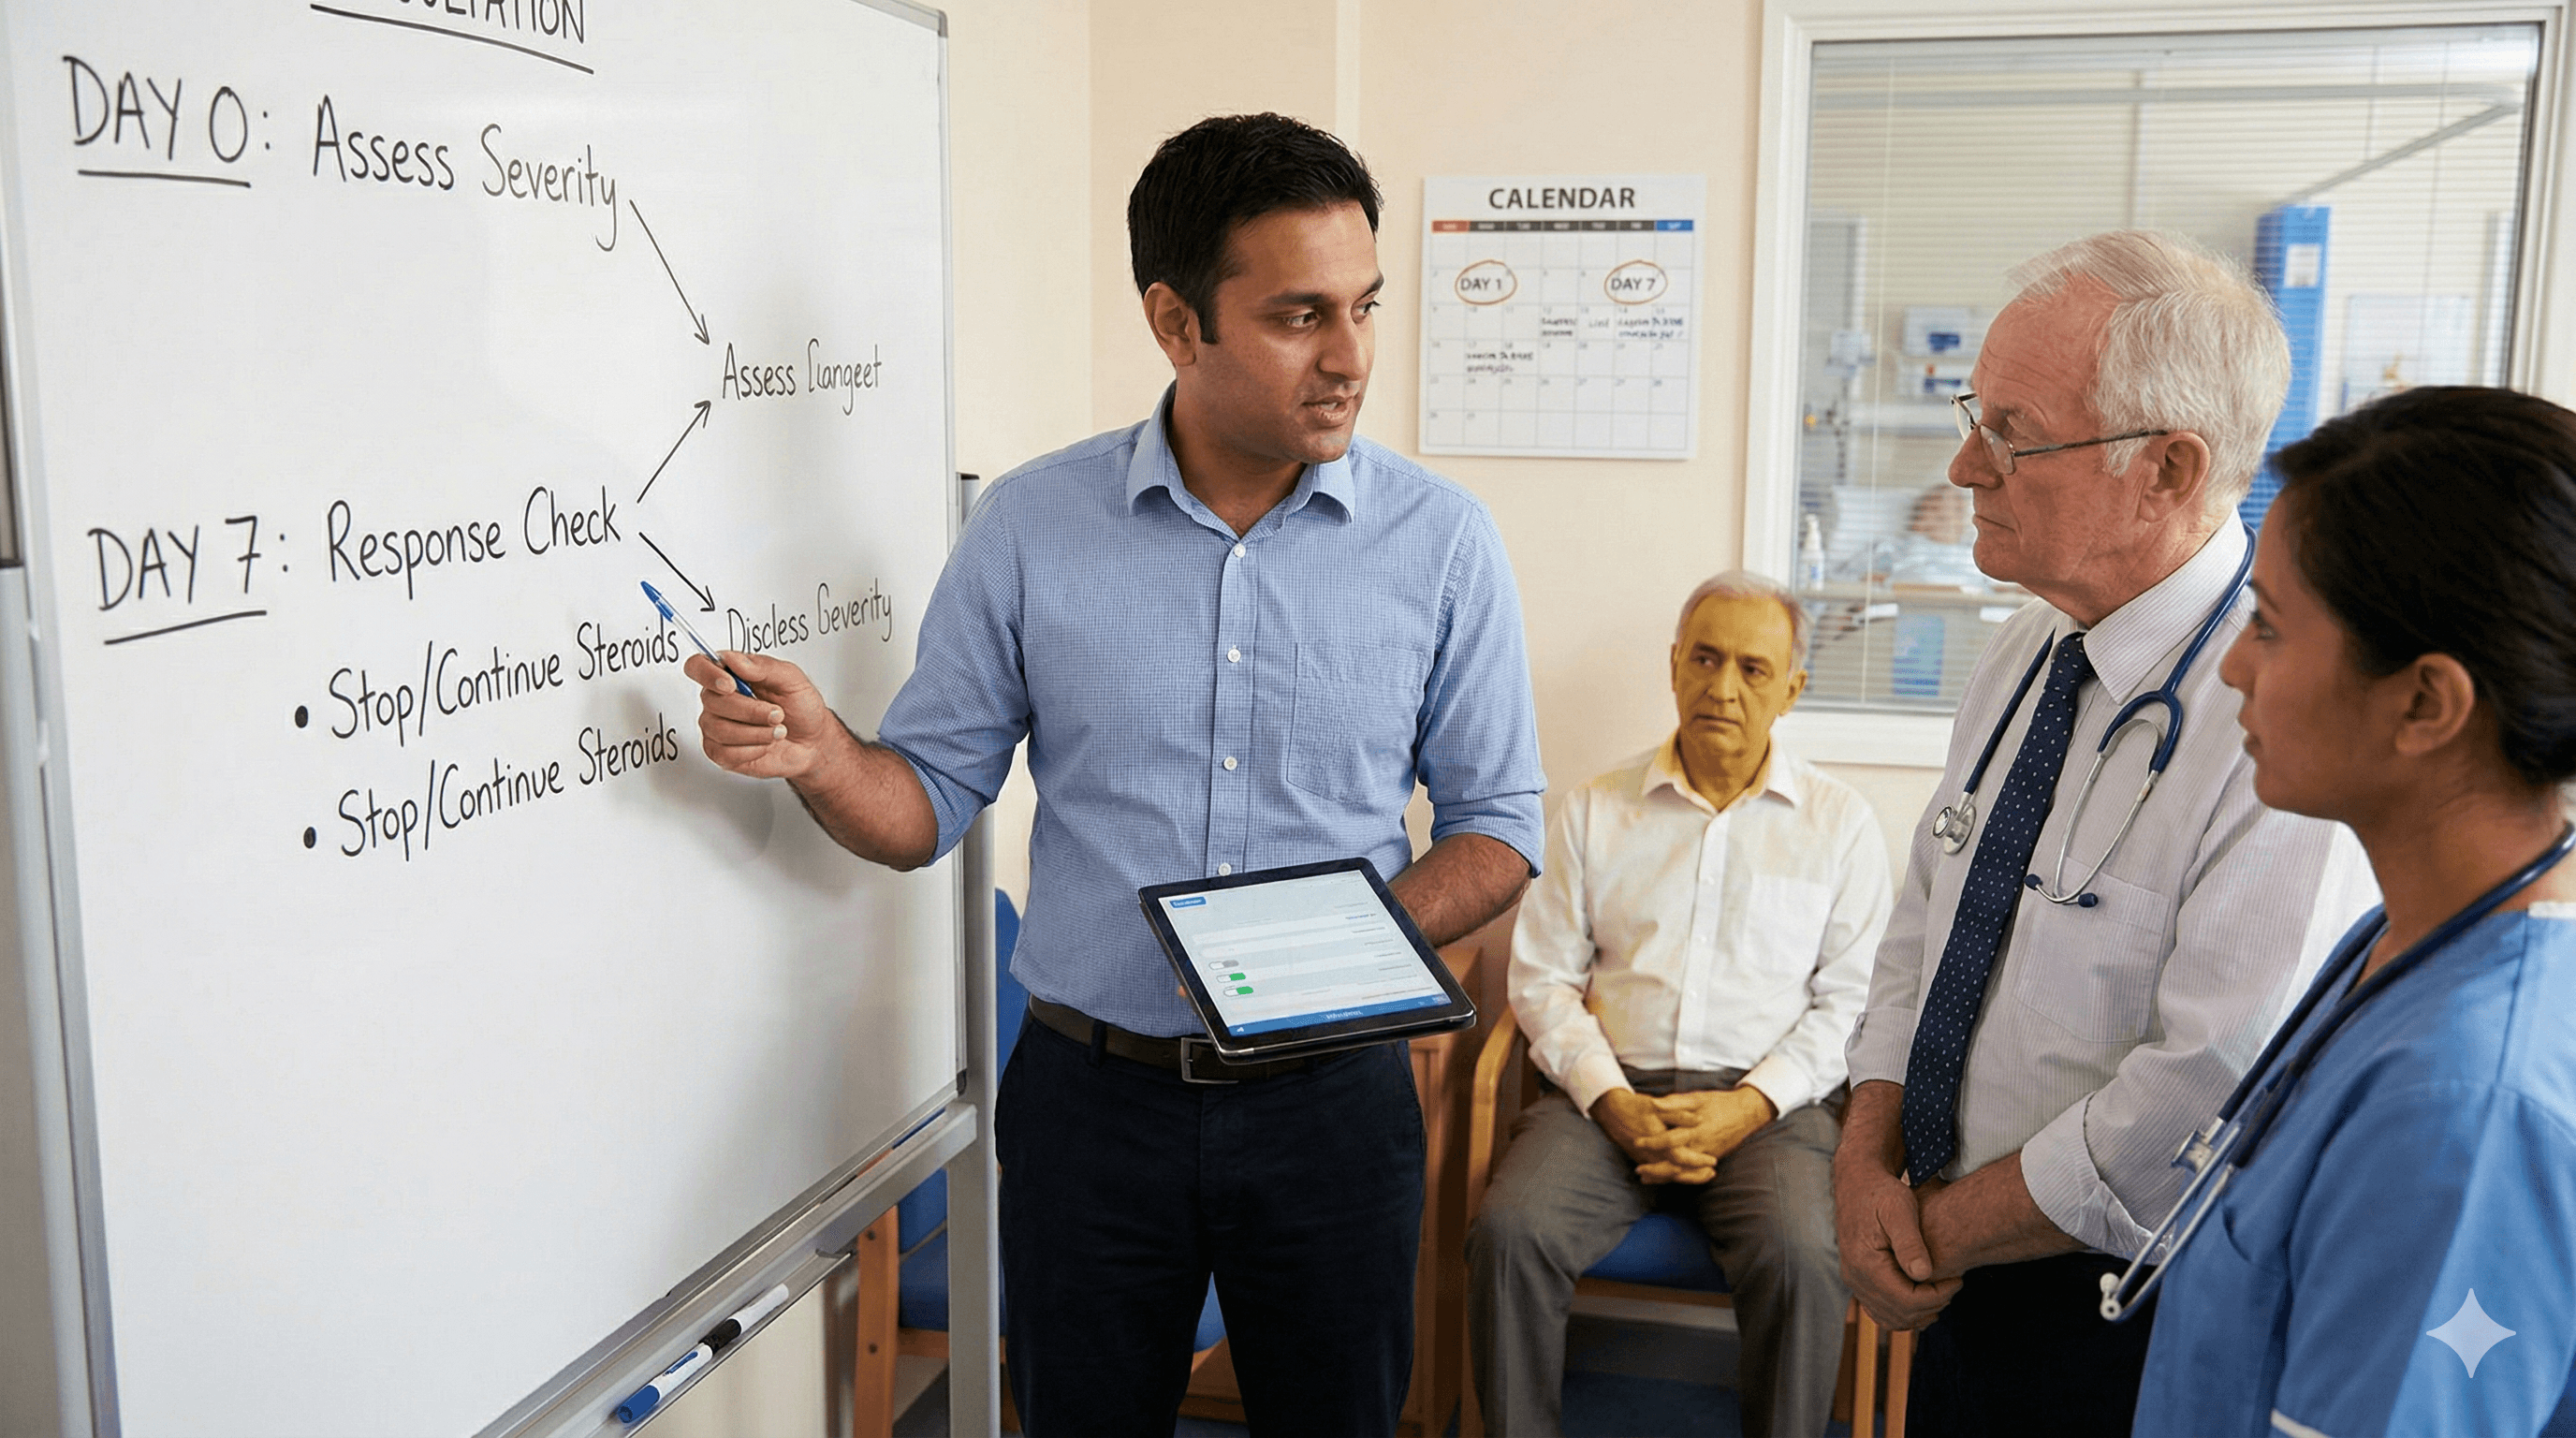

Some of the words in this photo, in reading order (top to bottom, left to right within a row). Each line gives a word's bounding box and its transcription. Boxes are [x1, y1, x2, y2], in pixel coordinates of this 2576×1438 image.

[400, 0, 584, 44] ATION
[63, 55, 182, 161] DAY
[313, 95, 455, 191] Assess
[480, 124, 617, 252] Severity
[1489, 187, 1635, 209] CALENDAR
[1460, 278, 1490, 290] DAY
[1496, 278, 1501, 290] 1
[1611, 278, 1642, 290] DAY
[1646, 278, 1656, 290] 7
[723, 342, 797, 401] Assess
[88, 525, 199, 611] DAY
[327, 499, 506, 601] Response
[523, 486, 622, 555] Check
[329, 640, 564, 748] Stop/Continue
[577, 613, 680, 682] Steroids
[338, 757, 564, 862] Stop/Continue
[578, 712, 680, 785] Steroids
